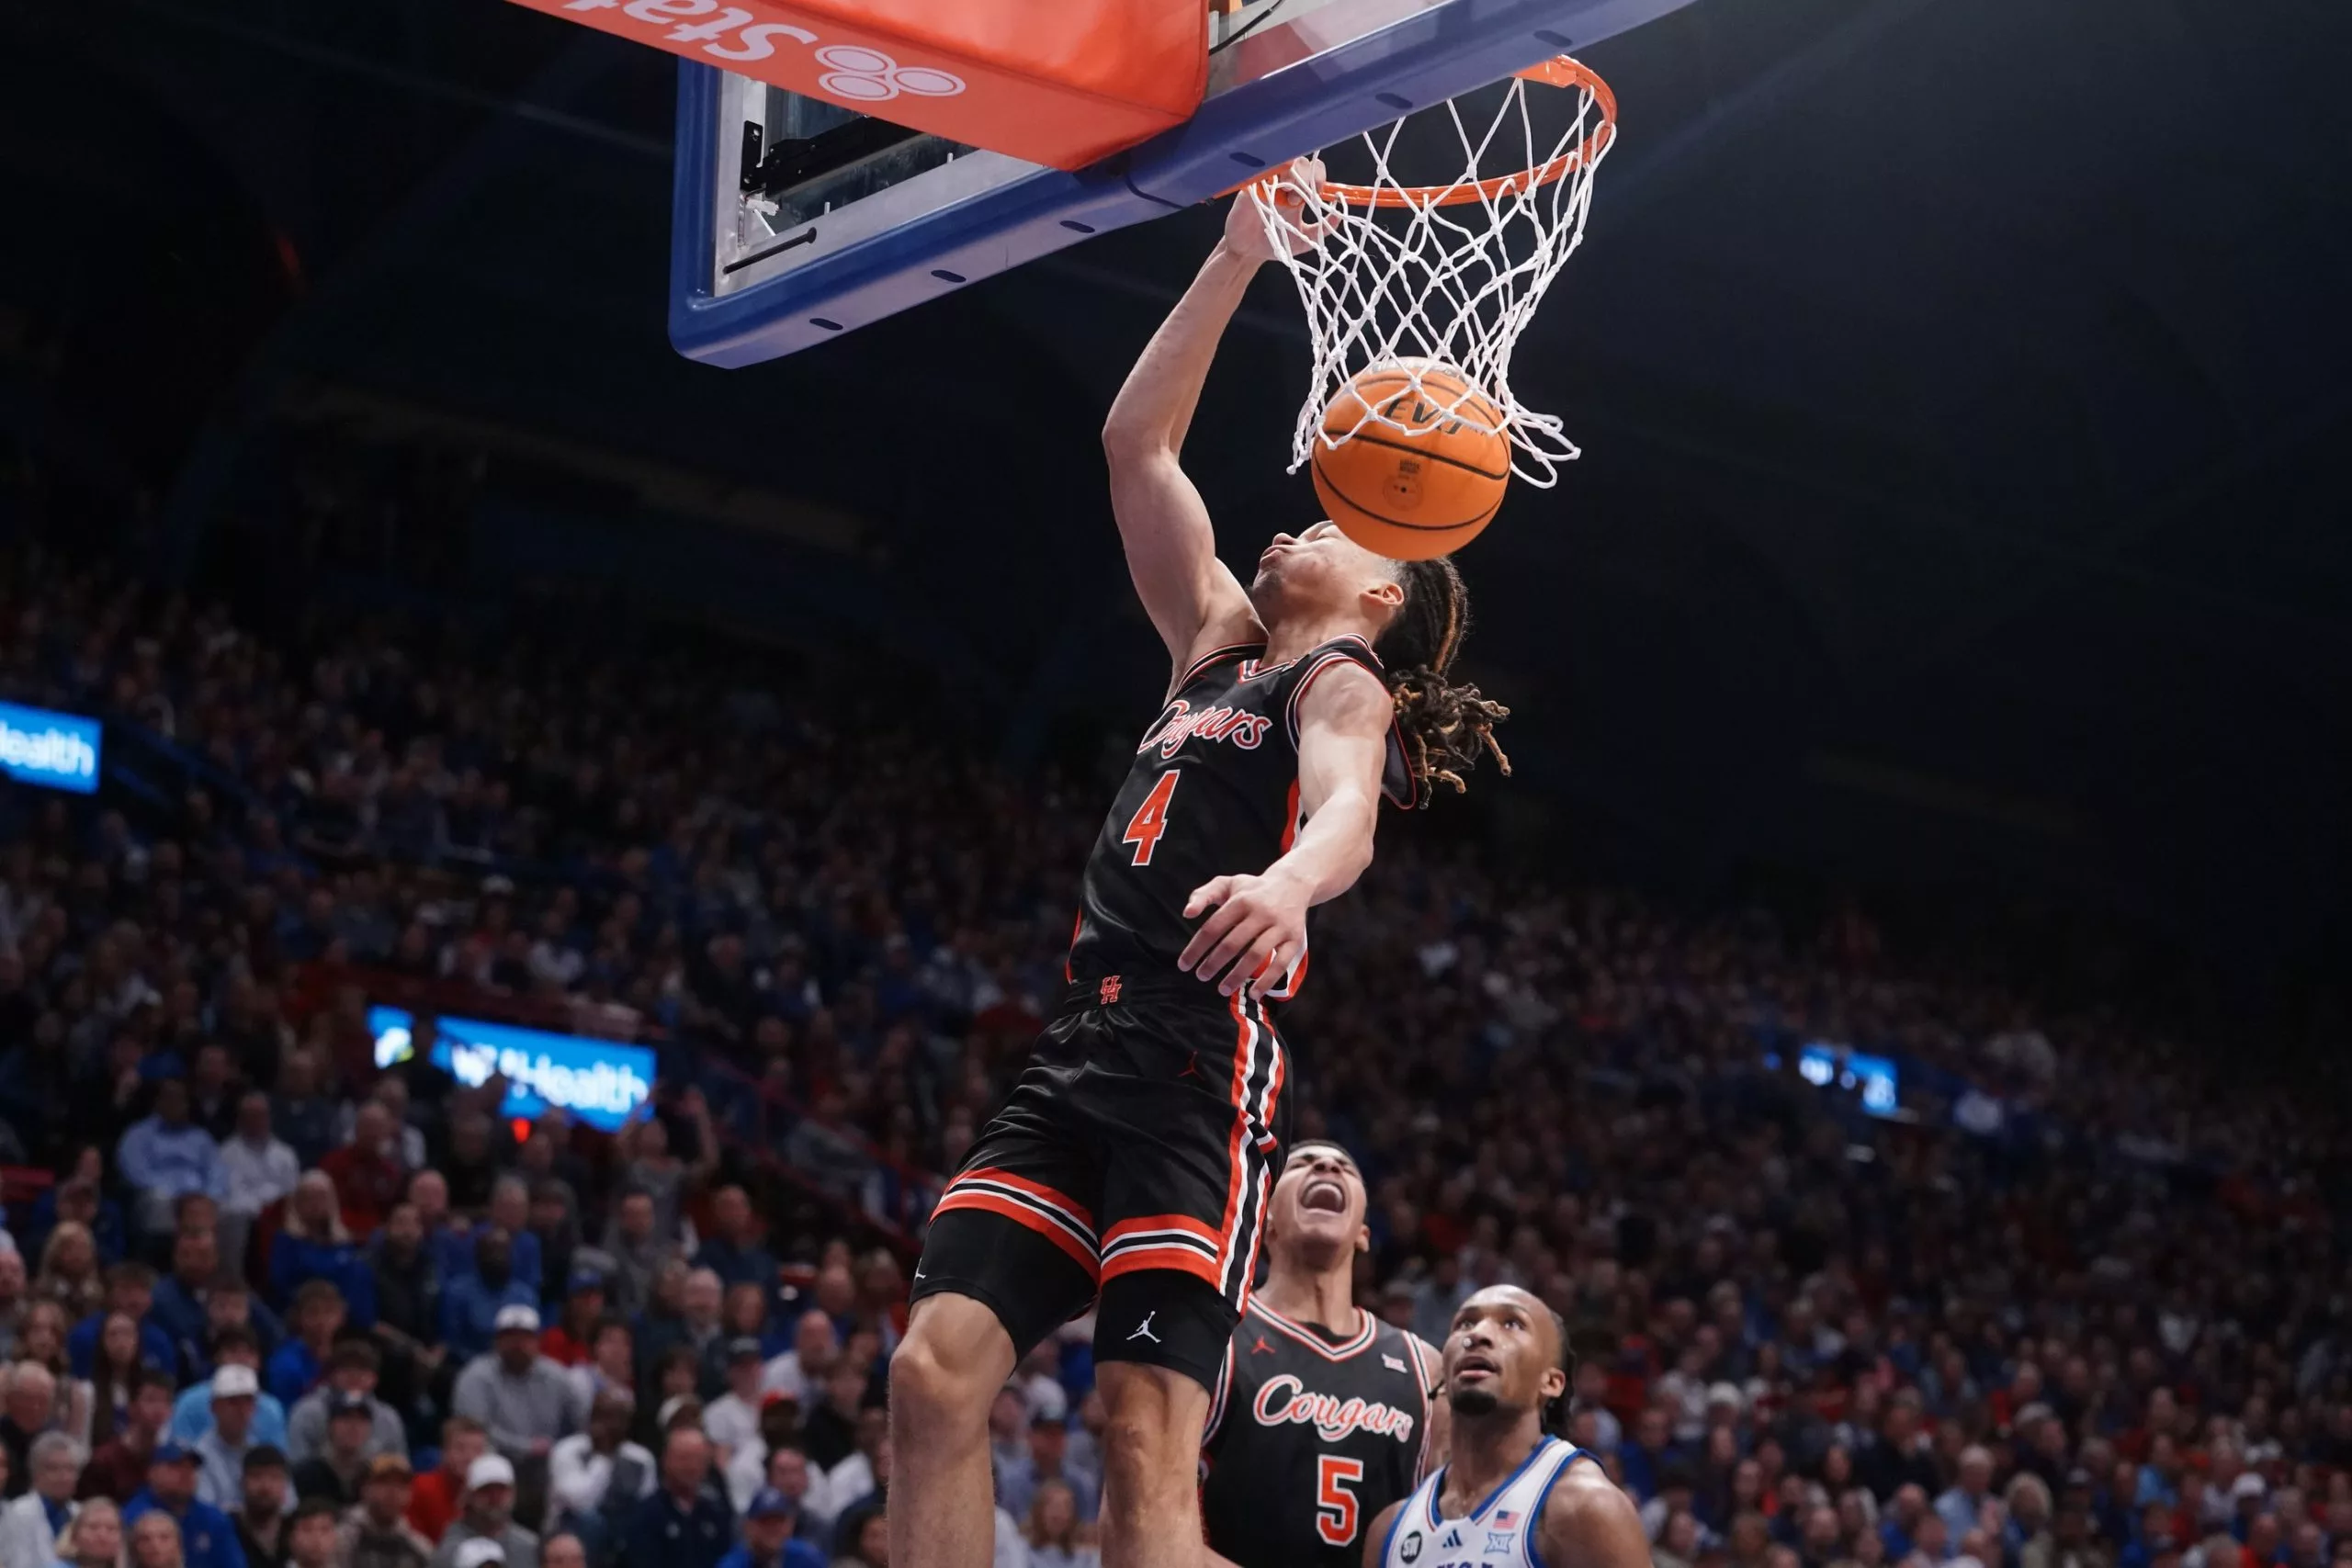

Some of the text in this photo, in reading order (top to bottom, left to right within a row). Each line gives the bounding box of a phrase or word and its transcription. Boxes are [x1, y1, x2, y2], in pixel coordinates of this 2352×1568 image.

[562, 0, 819, 61] Sta
[0, 719, 95, 778] ealth
[1122, 769, 1181, 866] 4
[1316, 1454, 1363, 1547] 5
